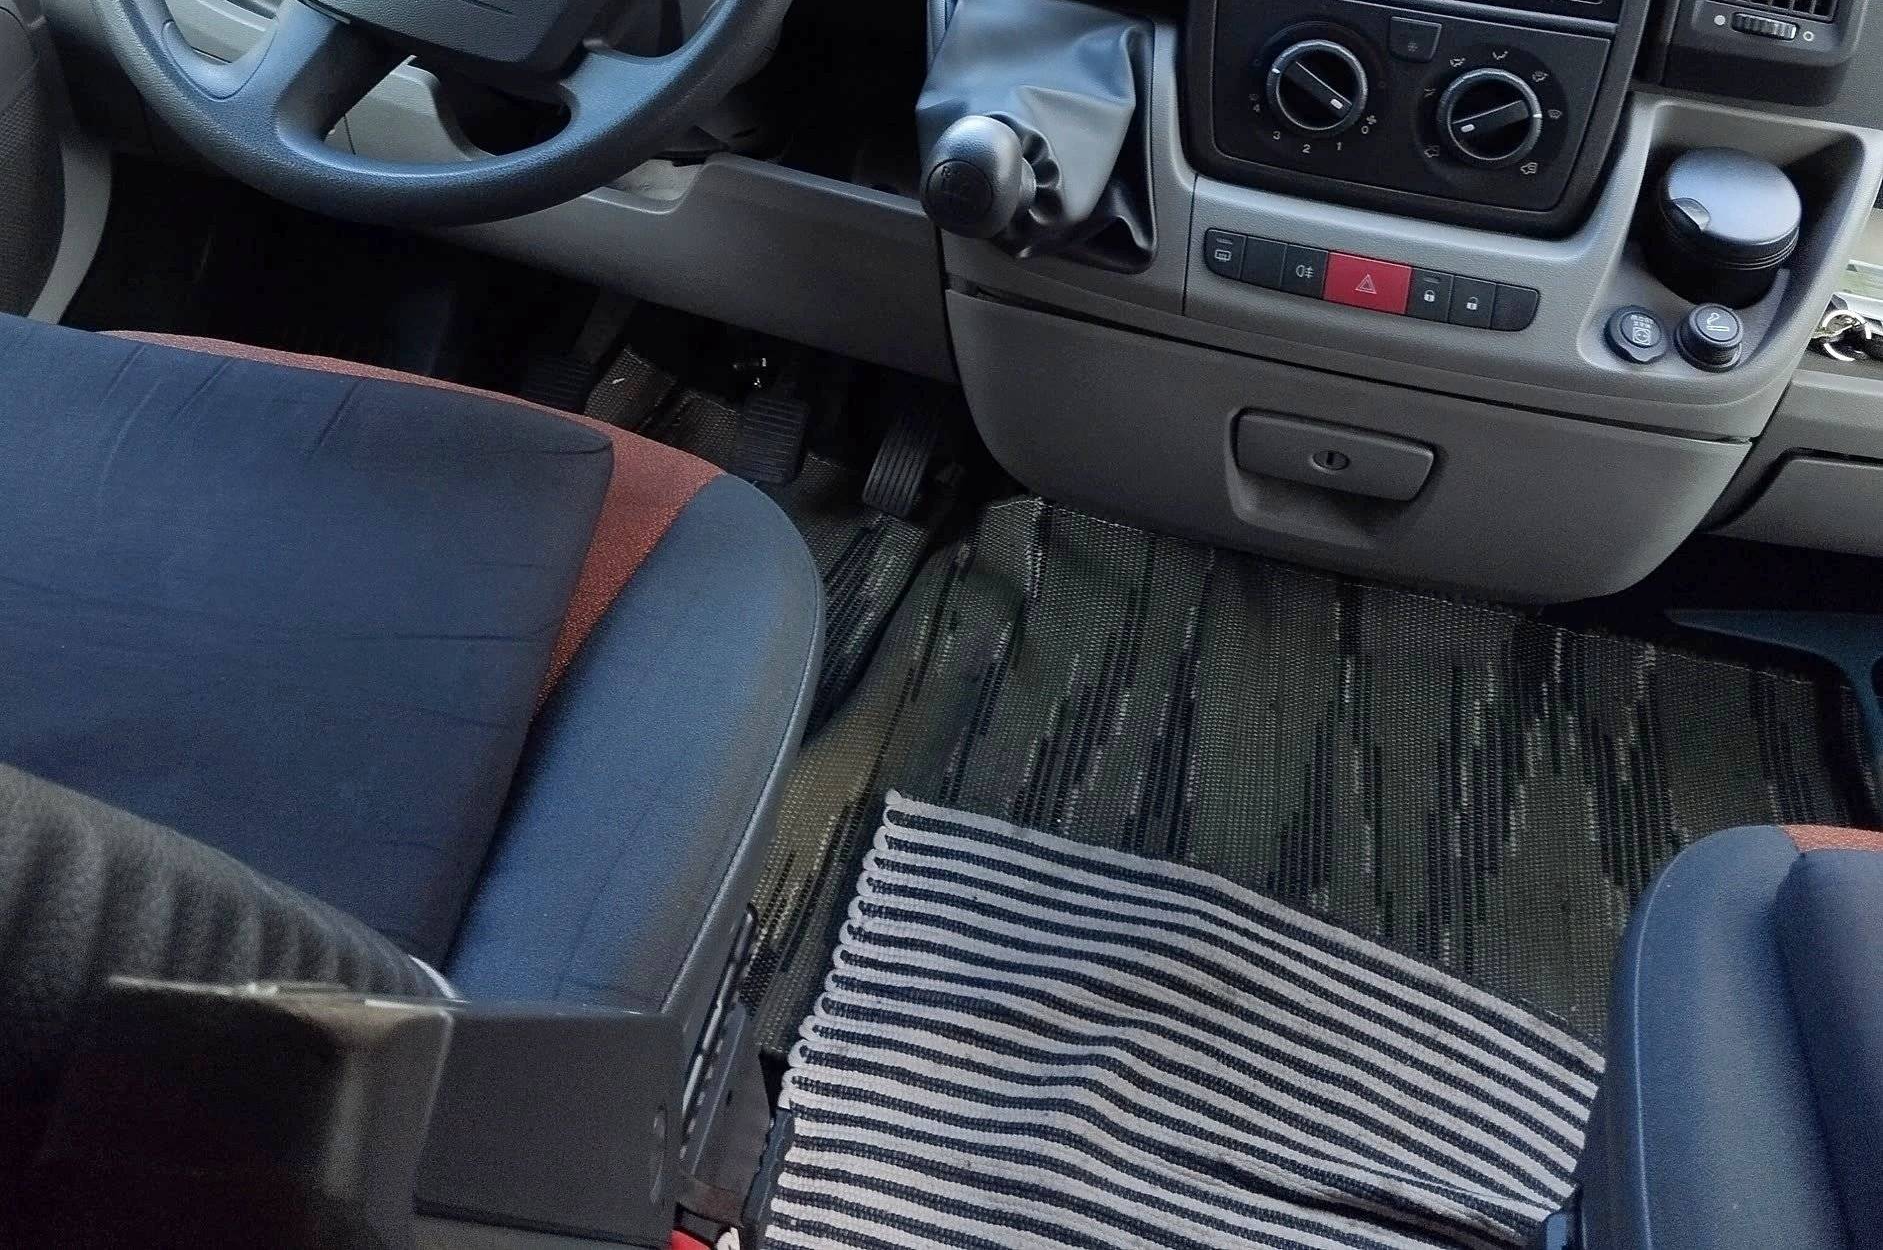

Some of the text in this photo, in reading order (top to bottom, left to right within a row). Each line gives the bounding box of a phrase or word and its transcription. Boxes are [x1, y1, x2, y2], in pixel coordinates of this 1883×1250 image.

[1273, 131, 1281, 140] 3
[1302, 143, 1311, 153] 2
[1336, 141, 1343, 151] 1
